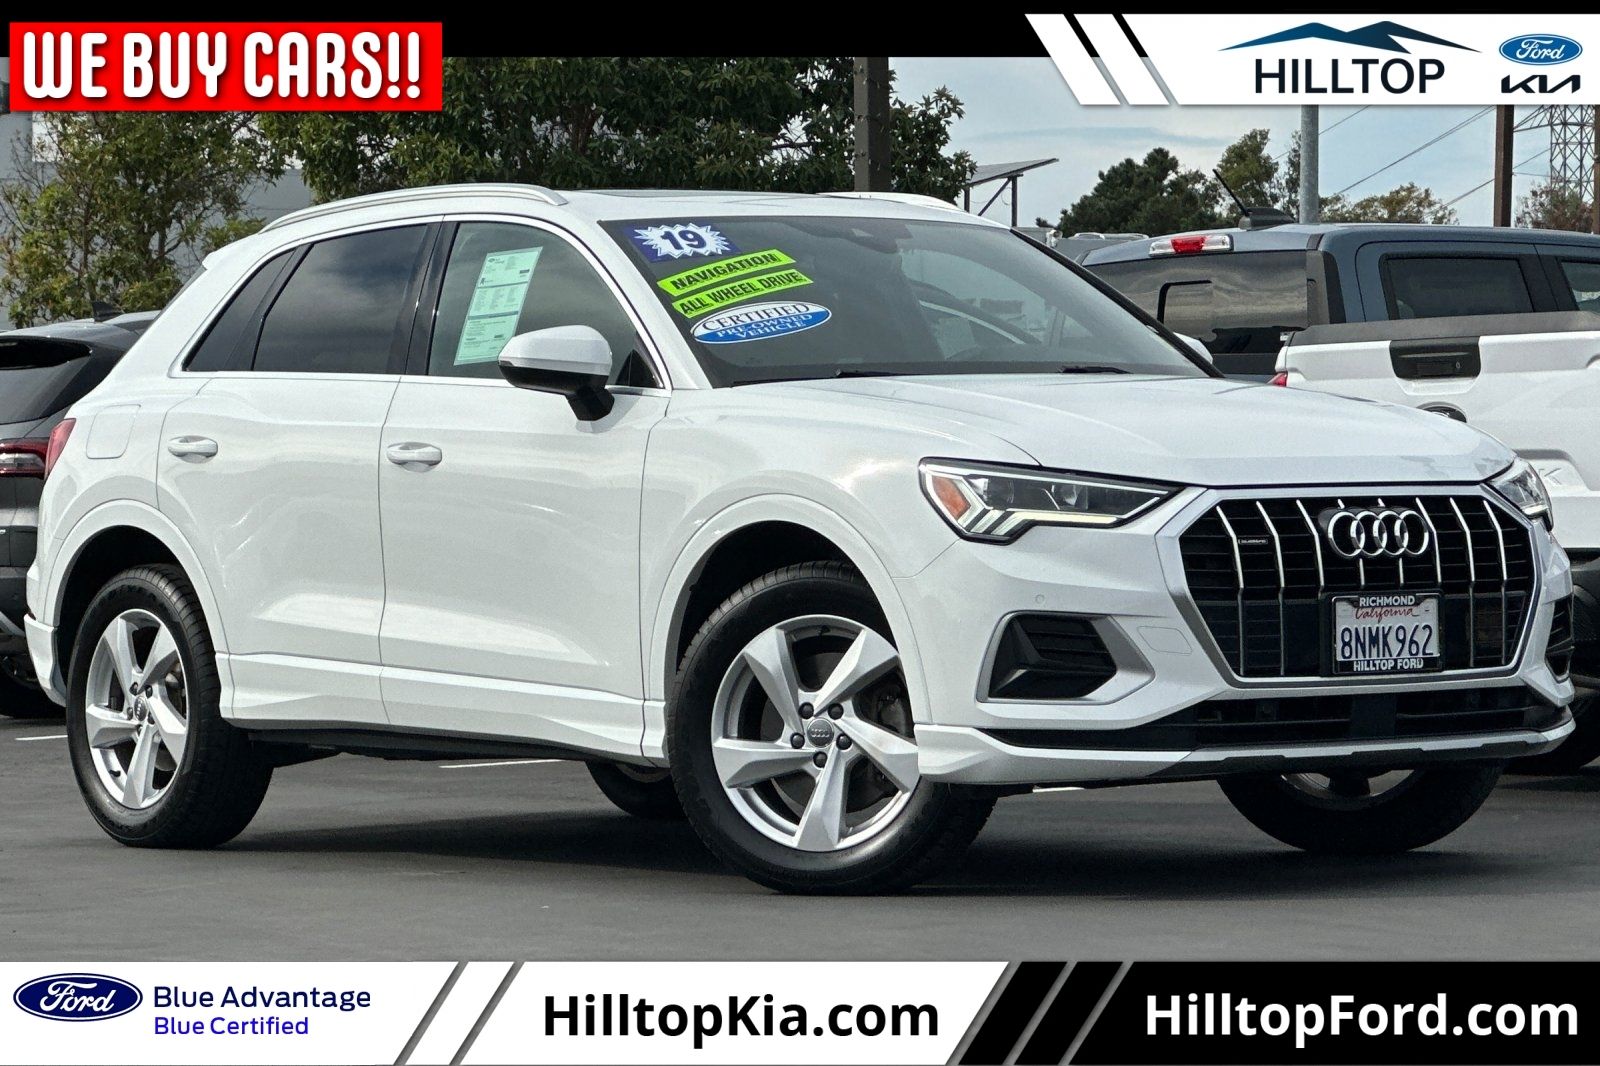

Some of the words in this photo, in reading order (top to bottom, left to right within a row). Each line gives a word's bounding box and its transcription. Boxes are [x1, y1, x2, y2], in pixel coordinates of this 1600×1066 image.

[661, 229, 706, 250] 19
[671, 253, 777, 290] NAVIGATION
[680, 298, 708, 315] ALL
[708, 281, 760, 303] WHEEL
[761, 271, 803, 289] DRIVE
[703, 303, 809, 331] CERTIFIED
[717, 313, 812, 338] PRE-OWNED
[736, 321, 806, 339] VEHICLE
[1359, 595, 1415, 607] RICHMOND
[1355, 607, 1420, 623] California
[1340, 624, 1434, 660] 8NMK962
[1353, 660, 1395, 672] HILLTOP
[1397, 658, 1424, 669] FORD
